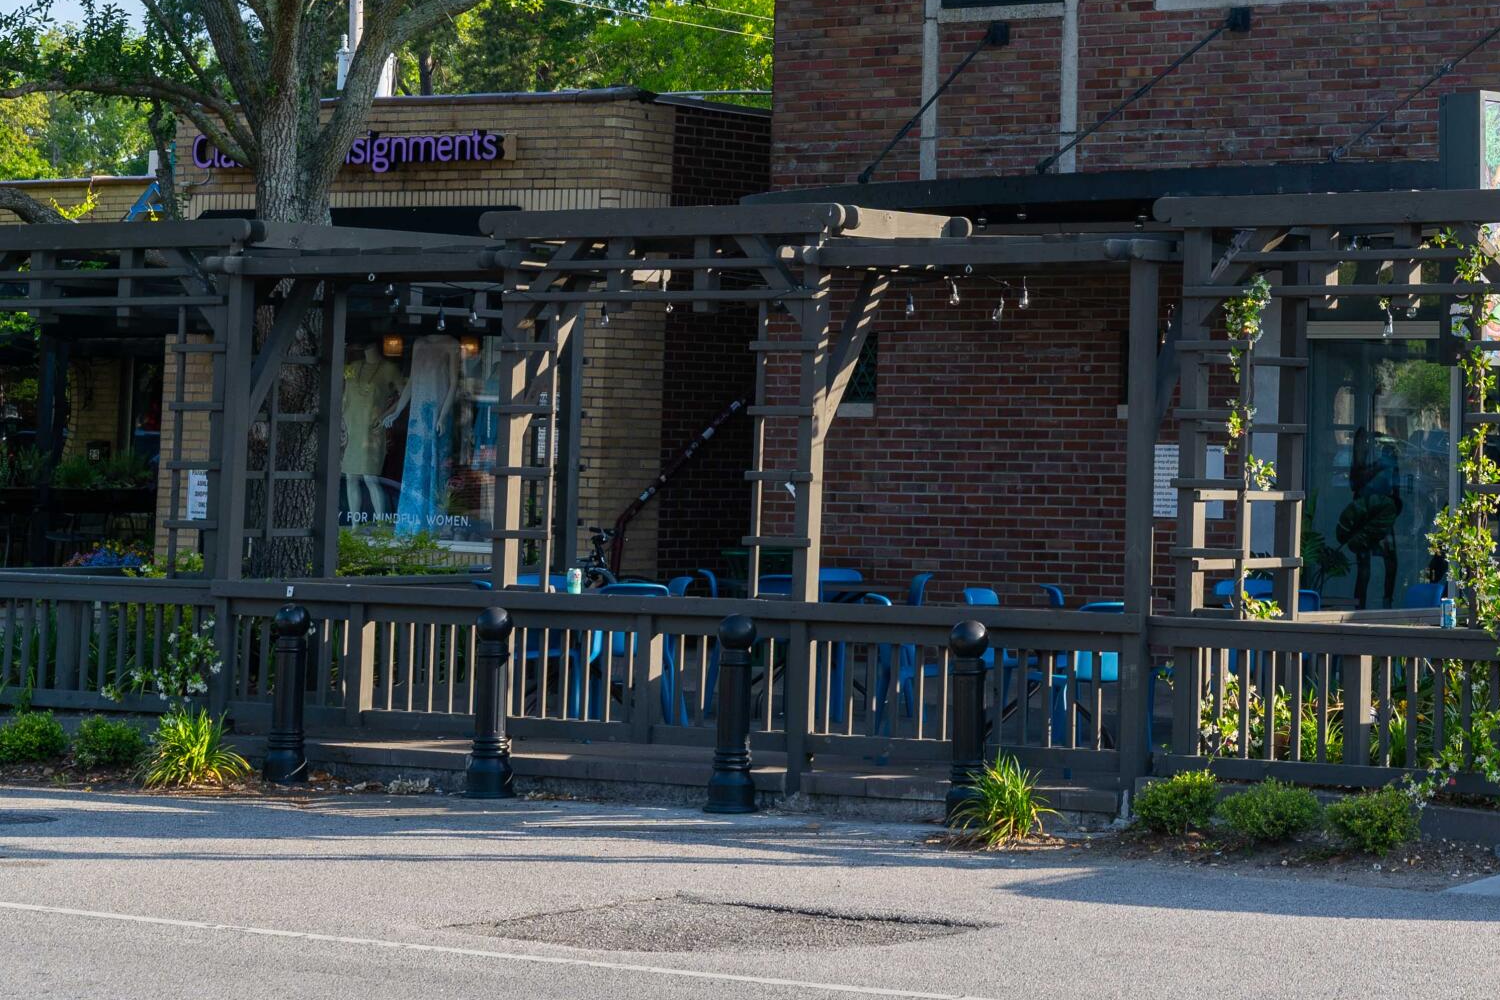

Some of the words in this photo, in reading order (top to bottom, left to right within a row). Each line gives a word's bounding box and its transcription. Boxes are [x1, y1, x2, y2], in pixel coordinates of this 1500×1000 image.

[347, 511, 368, 523] FOR
[372, 512, 421, 525] MINDFUL
[426, 514, 472, 528] WOMEN.
